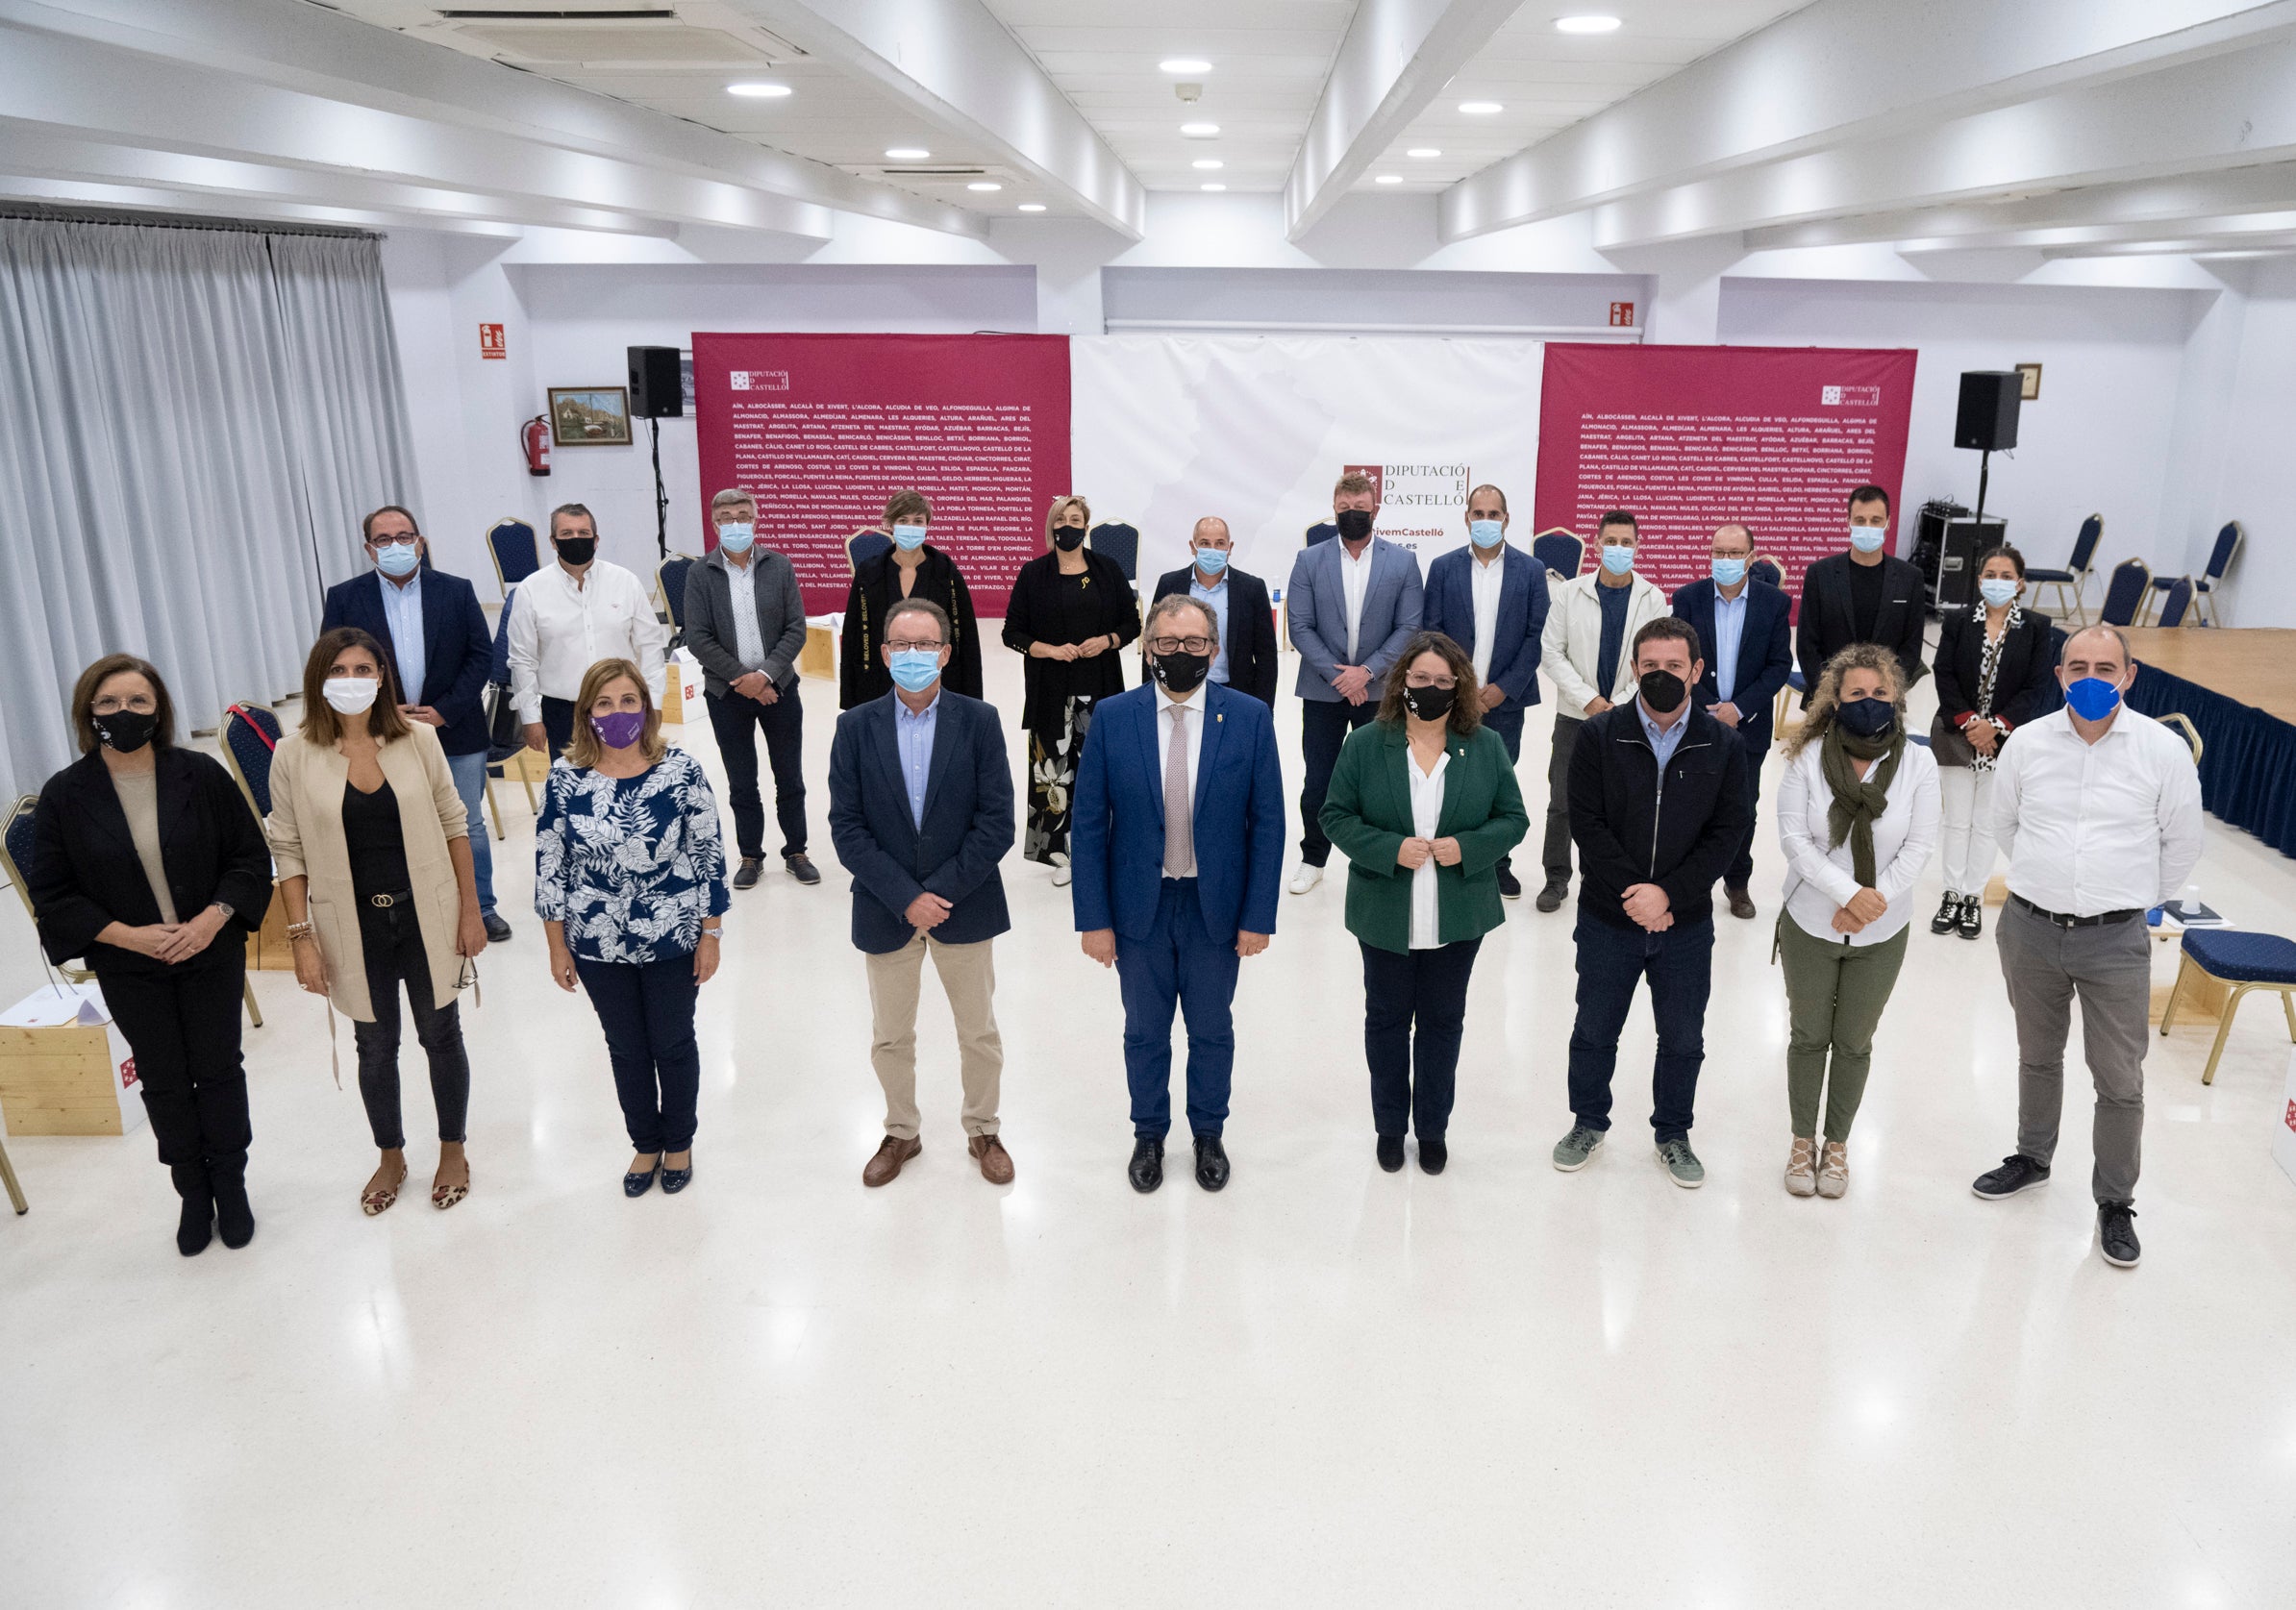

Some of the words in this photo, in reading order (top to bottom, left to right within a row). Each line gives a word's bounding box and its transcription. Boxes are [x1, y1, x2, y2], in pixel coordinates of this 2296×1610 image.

[1385, 462, 1465, 476] DIPUTACIÓ
[1385, 480, 1395, 490] D
[1456, 481, 1464, 491] E
[1384, 492, 1464, 506] CASTELLÓ
[1373, 527, 1444, 537] ivemCastelló
